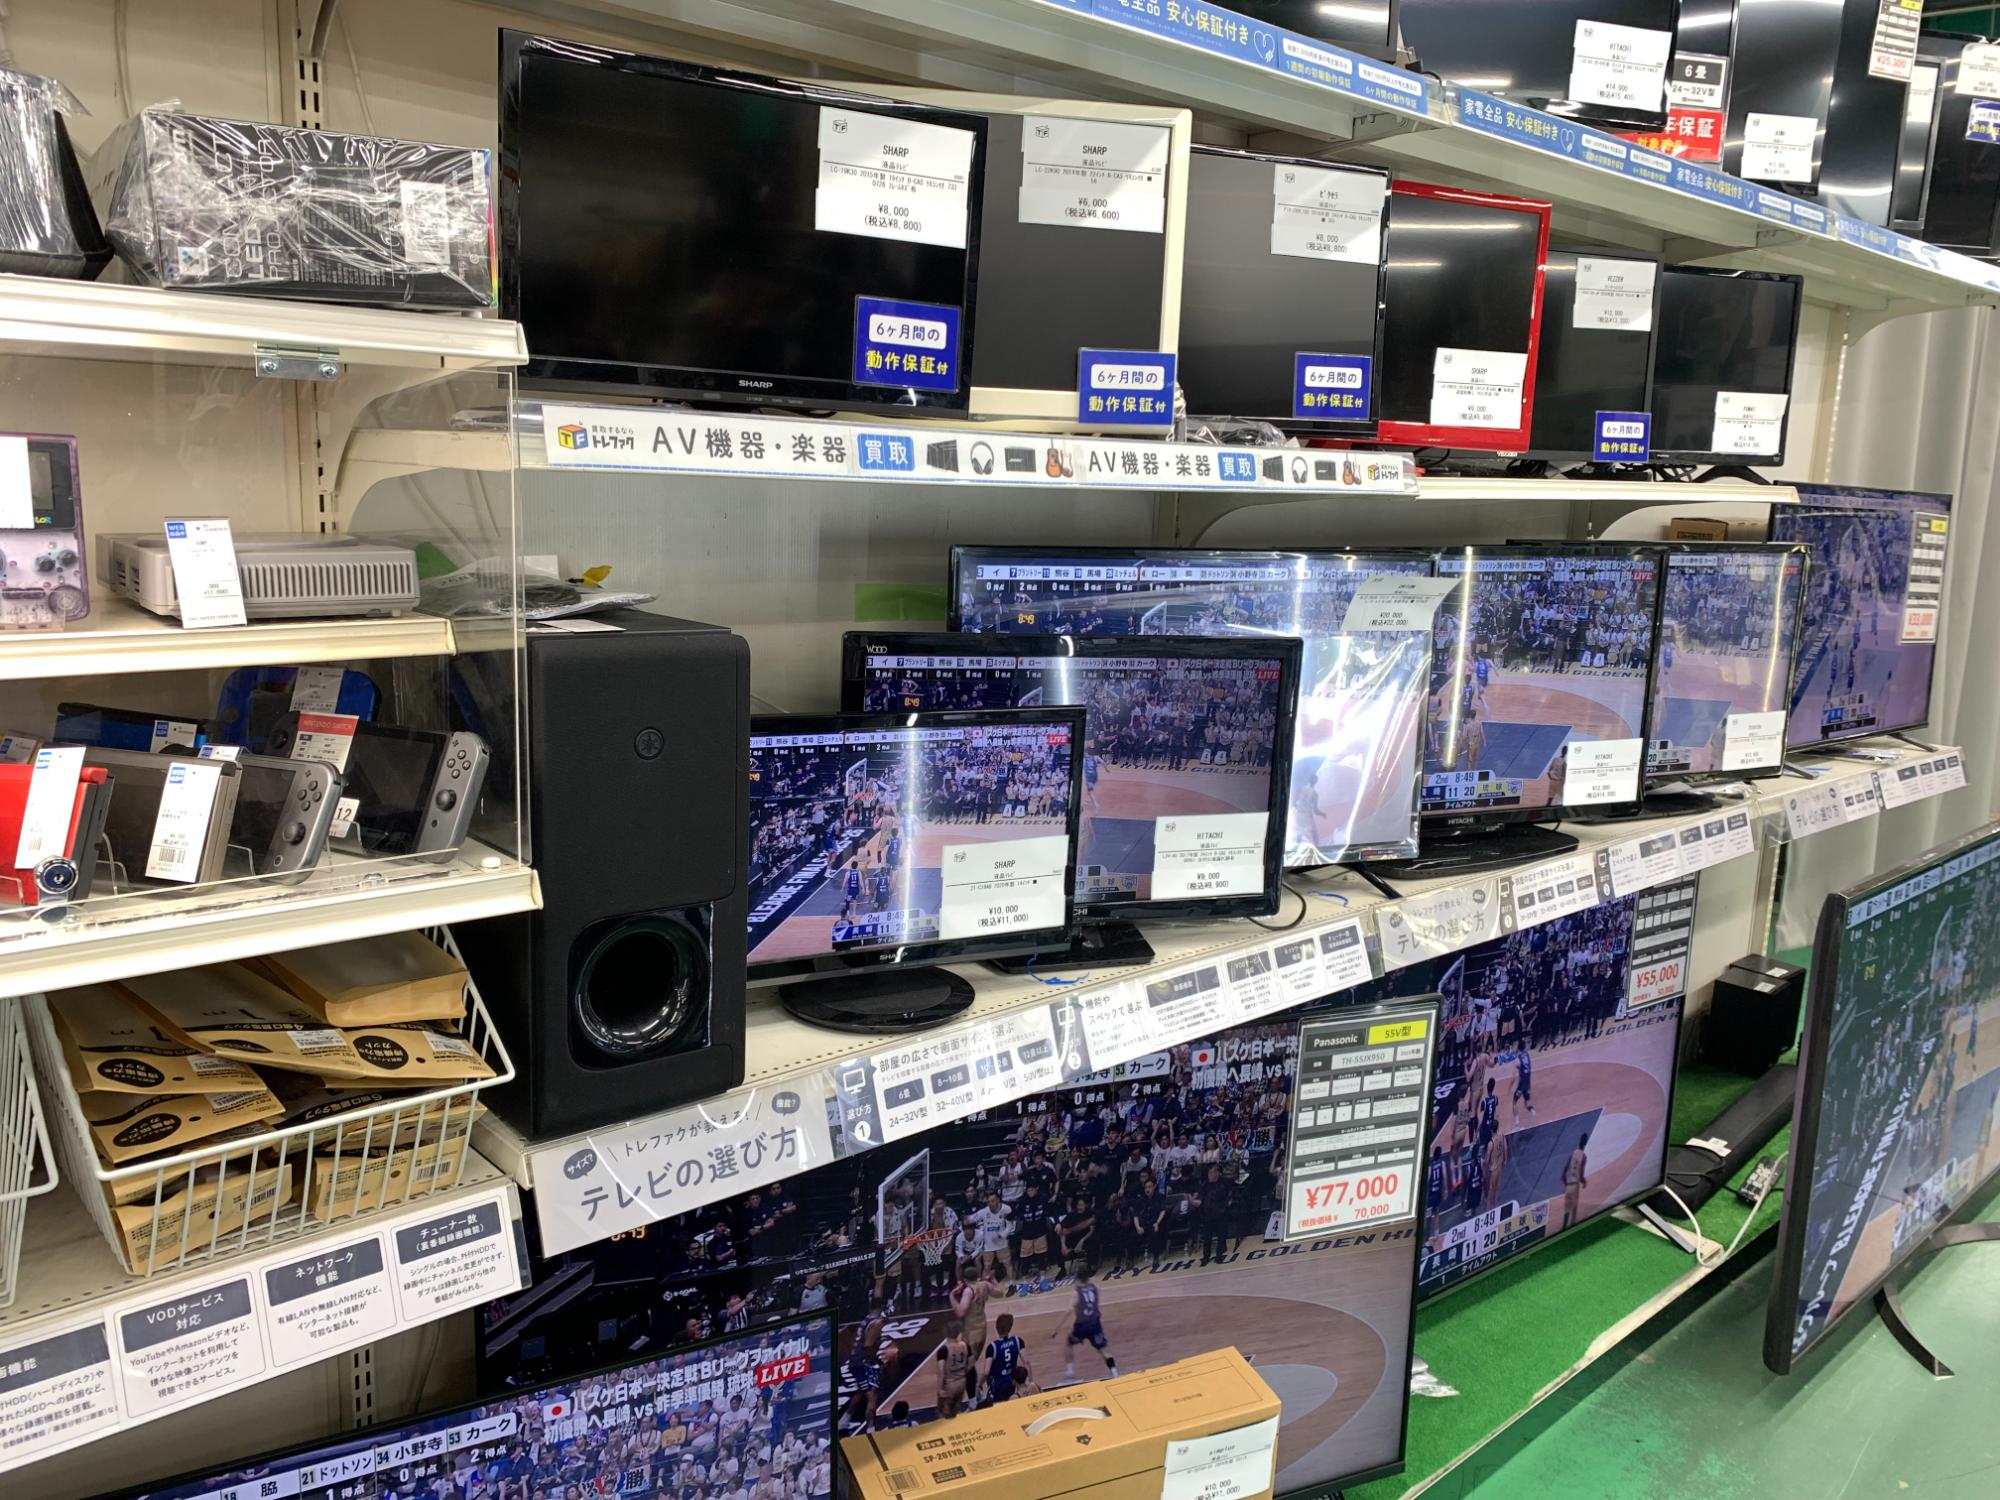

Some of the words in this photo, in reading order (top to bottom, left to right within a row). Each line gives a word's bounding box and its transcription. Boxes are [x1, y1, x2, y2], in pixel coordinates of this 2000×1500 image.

[1166, 2, 1249, 46] 安心保証付き
[1684, 64, 1707, 80] 6畳
[1464, 98, 1503, 125] 家電全品
[1506, 112, 1558, 141] 安心保証付き
[882, 145, 909, 158] SHARP
[1082, 145, 1108, 156] SHARP
[878, 203, 910, 217] ¥8,000
[1078, 197, 1108, 208] ¥6,000
[1064, 207, 1120, 221] (税込¥6,600)
[864, 215, 922, 232] (税込¥8,800)
[1315, 233, 1339, 243] ¥8,000
[243, 225, 265, 280] LED
[876, 322, 940, 342] 6ヶ月間の
[865, 350, 948, 376] 動作保証付
[1471, 367, 1488, 375] SHARP
[738, 379, 774, 389] SHARP
[1097, 370, 1158, 384] 6ヶ月間の
[1309, 371, 1357, 384] 6ヶ月間の
[1088, 395, 1166, 414] 動作保証付
[1302, 393, 1363, 409] 動作保証付
[591, 425, 634, 436] 買取するなら
[1606, 424, 1641, 436] 6ヶ月間の
[592, 433, 635, 451] トレファク
[653, 426, 847, 465] AV機器・楽器
[863, 440, 908, 465] 買取
[1600, 441, 1645, 455] 動作保証付
[1088, 451, 1211, 477] AV機器・楽器
[1222, 456, 1253, 480] 買取
[1632, 572, 1653, 581] LIVE
[1257, 670, 1280, 680] LIVE
[1571, 666, 1632, 678] GOLDEN
[1047, 736, 1067, 744] LIVE
[1184, 764, 1259, 776] GOLDEN
[1435, 775, 1449, 785] 2nd
[1454, 771, 1475, 783] 8:49
[1447, 786, 1458, 798] 11
[1463, 785, 1475, 797] 20
[335, 807, 352, 821] 12
[994, 818, 1053, 826] GOLDEN
[1447, 817, 1475, 825] HITACHI
[1196, 831, 1223, 840] HITACHI
[994, 859, 1016, 870] SHARP
[1196, 872, 1220, 881] ¥9,000
[1186, 880, 1230, 891] (税込¥9,900)
[988, 904, 1019, 916] ¥10,000
[867, 914, 880, 923] 2nd
[977, 913, 1029, 928] (税込¥11,000)
[880, 925, 890, 933] 11
[1636, 963, 1679, 989] ¥55,000
[1605, 1015, 1669, 1038] GOLDEN
[1313, 1033, 1359, 1048] Panasonic
[1384, 1025, 1412, 1039] 55V型
[1115, 1063, 1125, 1076] 53
[1128, 1058, 1166, 1076] カーク
[1266, 1065, 1283, 1078] vs
[898, 1090, 911, 1099] 6畳
[1027, 1099, 1048, 1113] 得点
[1085, 1090, 1105, 1104] 得点
[1141, 1083, 1161, 1096] 得点
[846, 1104, 872, 1121] 選び方
[566, 1152, 595, 1174] サイズ?
[580, 1125, 799, 1222] テレビの選び方
[1305, 1173, 1399, 1210] ¥77,000
[1354, 1203, 1390, 1219] 70,000
[420, 1213, 478, 1239] チューナー数
[1450, 1226, 1466, 1243] 2nd
[1473, 1211, 1495, 1232] 8:49
[1464, 1241, 1477, 1257] 11
[1483, 1231, 1497, 1248] 20
[295, 1251, 354, 1279] ネットワーク
[315, 1270, 339, 1287] 機能
[417, 1266, 496, 1298] ダブルは録画しながら他の
[434, 1283, 485, 1304] 番組がみられる。
[146, 1292, 225, 1325] VODサービス
[297, 1301, 367, 1331] インターネット接続が
[175, 1313, 203, 1332] 対応
[309, 1319, 360, 1339] 可能な製品も。
[147, 1338, 239, 1375] インターネットを利用して
[149, 1352, 240, 1388] 様々な映像コンテンツを
[158, 1367, 236, 1399] 視聴できるサービス。
[543, 1408, 631, 1446] 初優勝へ長崎
[633, 1403, 654, 1418] vs
[656, 1381, 725, 1414] 昨季準優勝
[727, 1370, 758, 1394] 琉球
[759, 1357, 807, 1385] LIVE
[260, 1483, 278, 1498] 脇
[302, 1470, 315, 1485] 21
[318, 1456, 372, 1482] ドットソン
[377, 1452, 390, 1465] 34
[394, 1437, 444, 1461] 小野寺
[449, 1431, 461, 1445] 53
[466, 1418, 512, 1441] カーク
[340, 1484, 365, 1499] 得点
[414, 1464, 438, 1480] 得点
[484, 1445, 508, 1458] 得点
[1204, 1479, 1232, 1491] ¥10,000
